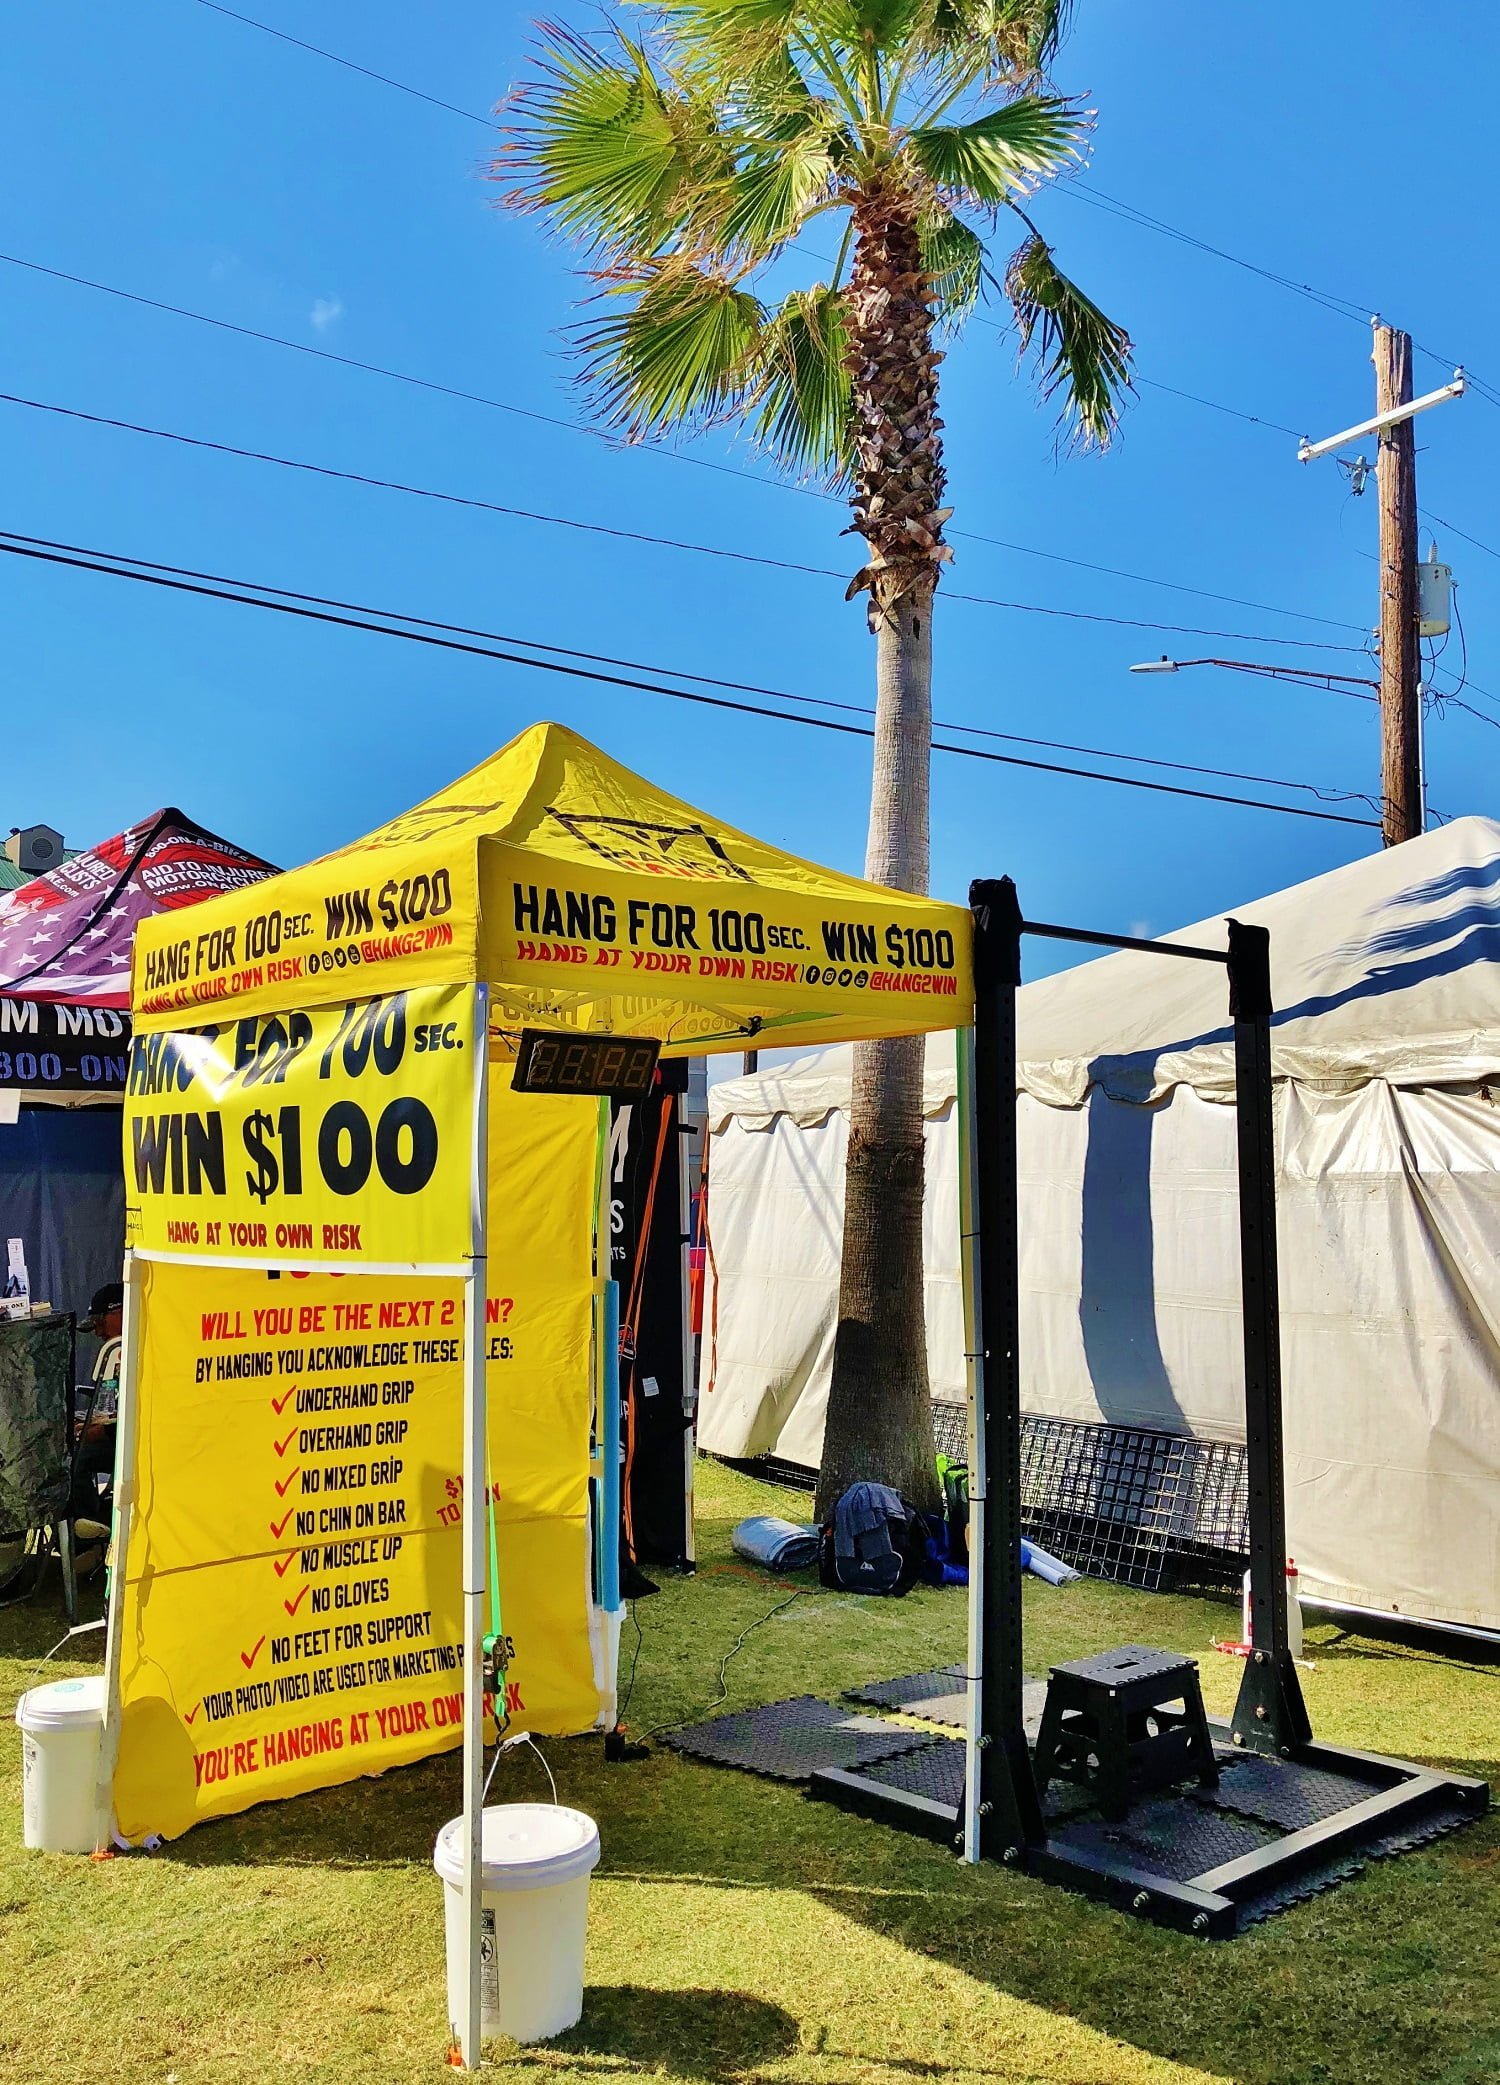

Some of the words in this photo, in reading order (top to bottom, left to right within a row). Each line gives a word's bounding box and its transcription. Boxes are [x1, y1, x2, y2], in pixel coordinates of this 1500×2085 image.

[141, 861, 173, 881] AID
[173, 861, 201, 872] TO
[145, 940, 190, 991] HANG
[195, 925, 237, 976] FOR
[245, 910, 282, 961] 100
[283, 913, 314, 940] SEC.
[324, 888, 374, 941] WIN
[378, 868, 452, 932] $100
[514, 882, 617, 943] HANG
[628, 900, 701, 950] FOR
[708, 909, 765, 954] 100
[767, 925, 811, 950] SEC.
[822, 921, 879, 965] WIN
[886, 923, 955, 969] $100
[141, 992, 175, 1015] HANG
[175, 987, 191, 1006] AT
[191, 976, 228, 1001] YOUR
[231, 966, 263, 992] OWN
[267, 956, 303, 983] RISK
[360, 922, 453, 964] @HANG2WIN
[517, 940, 588, 964] HANG
[593, 948, 623, 966] AT
[630, 950, 692, 974] YOUR
[699, 956, 746, 979] OWN
[751, 959, 798, 983] RISK
[870, 971, 957, 995] @HANG2WIN
[233, 1012, 314, 1089] FOR
[319, 990, 408, 1080] 100
[414, 1022, 464, 1052] SEC.
[132, 1111, 226, 1195] WIN
[167, 1220, 199, 1245] HANG
[206, 1222, 221, 1245] AT
[228, 1223, 267, 1247] YOUR
[275, 1223, 313, 1249] OWN
[322, 1224, 362, 1250] RISK
[202, 1311, 247, 1341] WILL
[254, 1308, 293, 1336] YOU
[299, 1305, 327, 1333] BE
[333, 1303, 373, 1331] THE
[379, 1301, 435, 1329] NEXT
[441, 1299, 455, 1325] 2
[462, 1298, 514, 1324] N?
[195, 1357, 213, 1383] BY
[216, 1351, 273, 1381] HANGING
[277, 1349, 304, 1375] YOU
[307, 1342, 408, 1372] ACKNOWLEDGE
[413, 1339, 459, 1364] THESE
[296, 1383, 378, 1413] UNDERHAND
[382, 1380, 414, 1405] GRIP
[299, 1423, 372, 1453] OVERHAND
[376, 1420, 408, 1445] GRIP
[302, 1469, 320, 1494] NO
[324, 1463, 366, 1492] MIXED
[297, 1510, 315, 1536] NO
[320, 1506, 351, 1533] CHIN
[355, 1503, 374, 1528] ON
[378, 1499, 406, 1525] BAR
[436, 1503, 461, 1526] TO
[301, 1548, 319, 1574] NO
[323, 1539, 378, 1570] MUSCLE
[383, 1536, 402, 1560] UP
[312, 1587, 330, 1613] NO
[335, 1578, 389, 1609] GLOVES
[271, 1637, 290, 1664] NO
[295, 1629, 330, 1659] FEET
[335, 1623, 363, 1651] FOR
[367, 1611, 431, 1645] SUPPORT
[203, 1690, 234, 1722] YOUR
[236, 1673, 310, 1714] PHOTO/VIDEO
[313, 1667, 335, 1696] ARE
[336, 1662, 366, 1690] USED
[368, 1657, 392, 1685] FOR
[393, 1645, 456, 1679] MARKETING
[193, 1738, 258, 1787] YOU'RE
[264, 1718, 343, 1768] HANGING
[350, 1712, 369, 1745] AT
[374, 1701, 431, 1739] YOUR
[483, 1682, 526, 1718] RK
